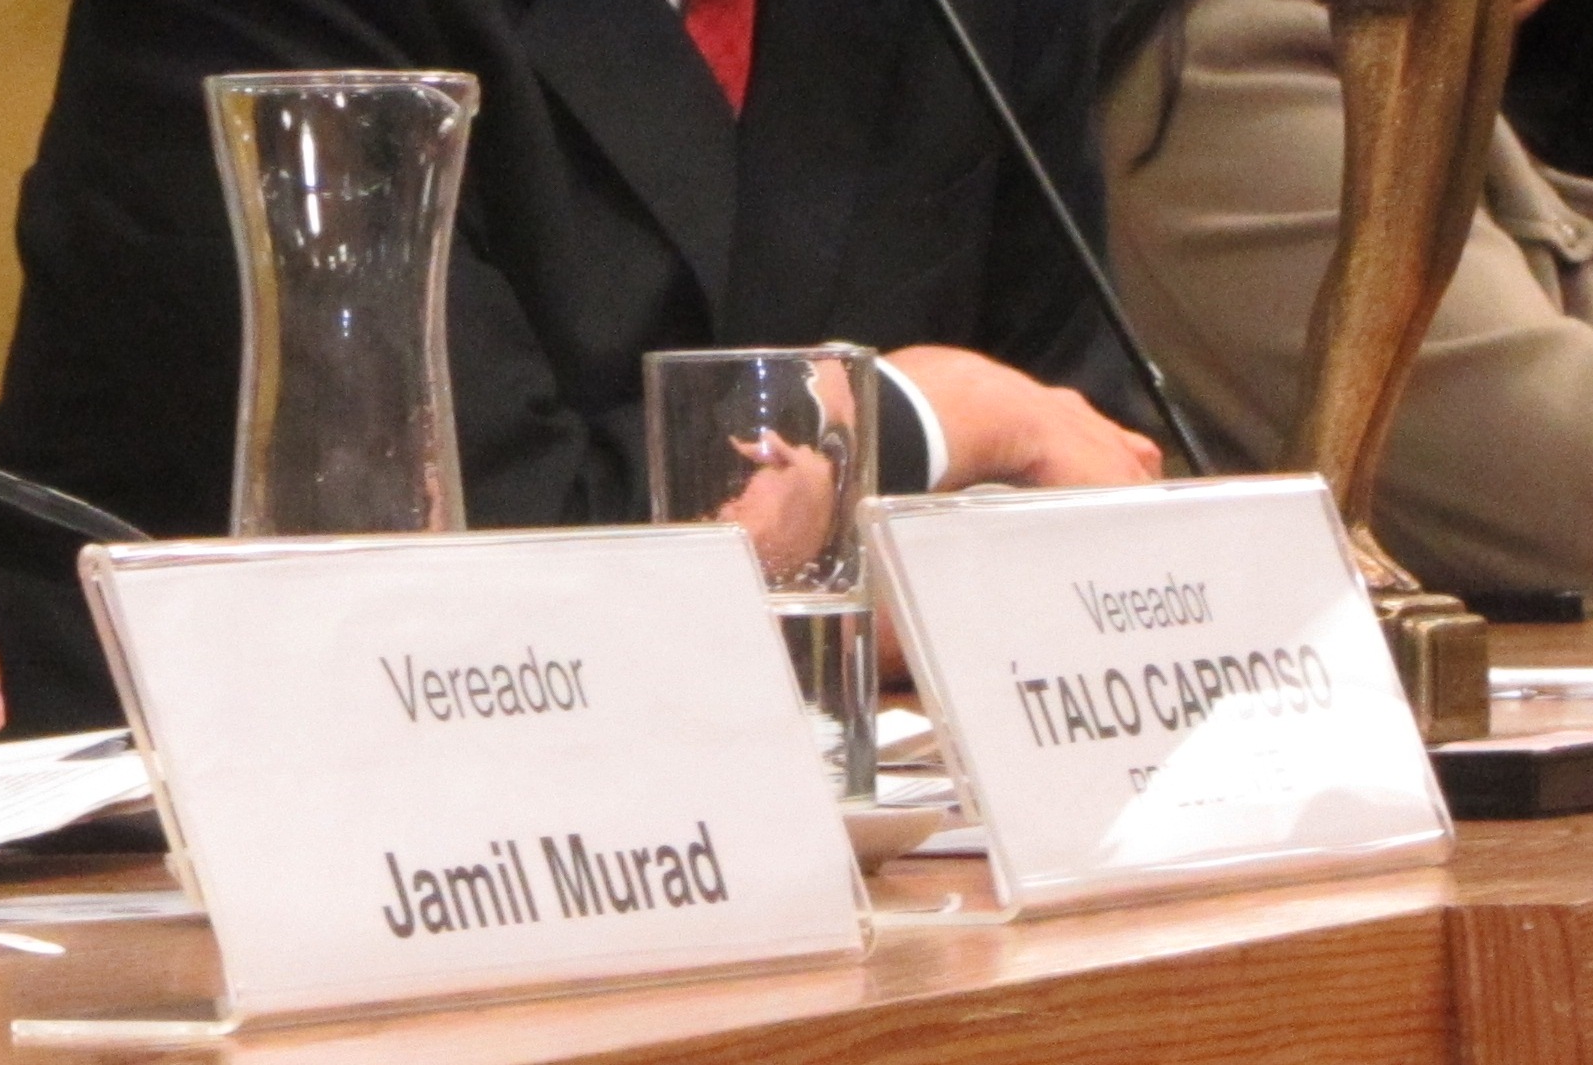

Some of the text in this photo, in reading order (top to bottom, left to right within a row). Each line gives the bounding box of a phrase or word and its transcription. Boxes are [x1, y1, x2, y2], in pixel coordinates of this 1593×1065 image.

[1072, 573, 1212, 634] Vereador
[379, 646, 591, 724] Vereador
[1010, 658, 1144, 748] ÍTALO
[382, 821, 730, 939] Jamil Murad
